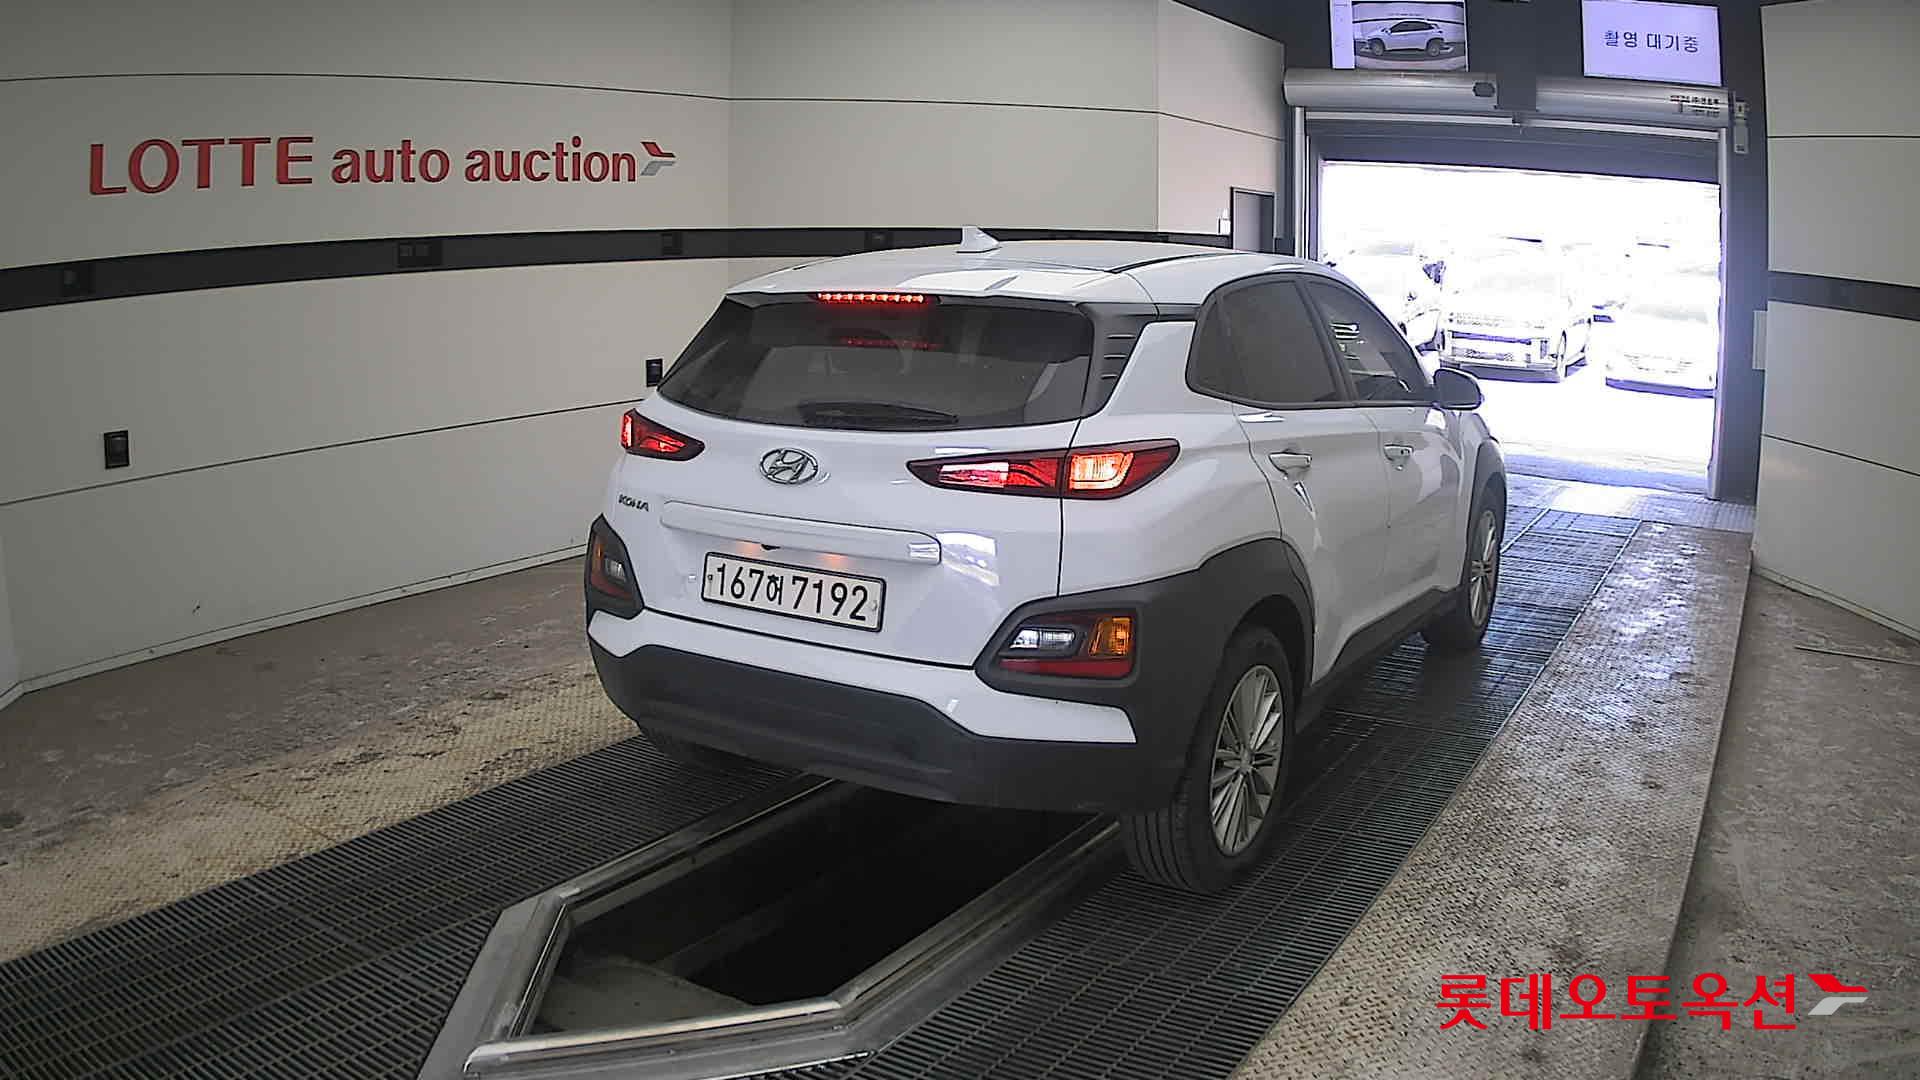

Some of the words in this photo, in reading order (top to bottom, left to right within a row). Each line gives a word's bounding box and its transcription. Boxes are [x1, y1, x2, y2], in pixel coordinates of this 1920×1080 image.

[1646, 33, 1699, 53] 대기중
[90, 136, 314, 195] LOTTE
[331, 138, 450, 184] auto
[464, 135, 637, 184] auction
